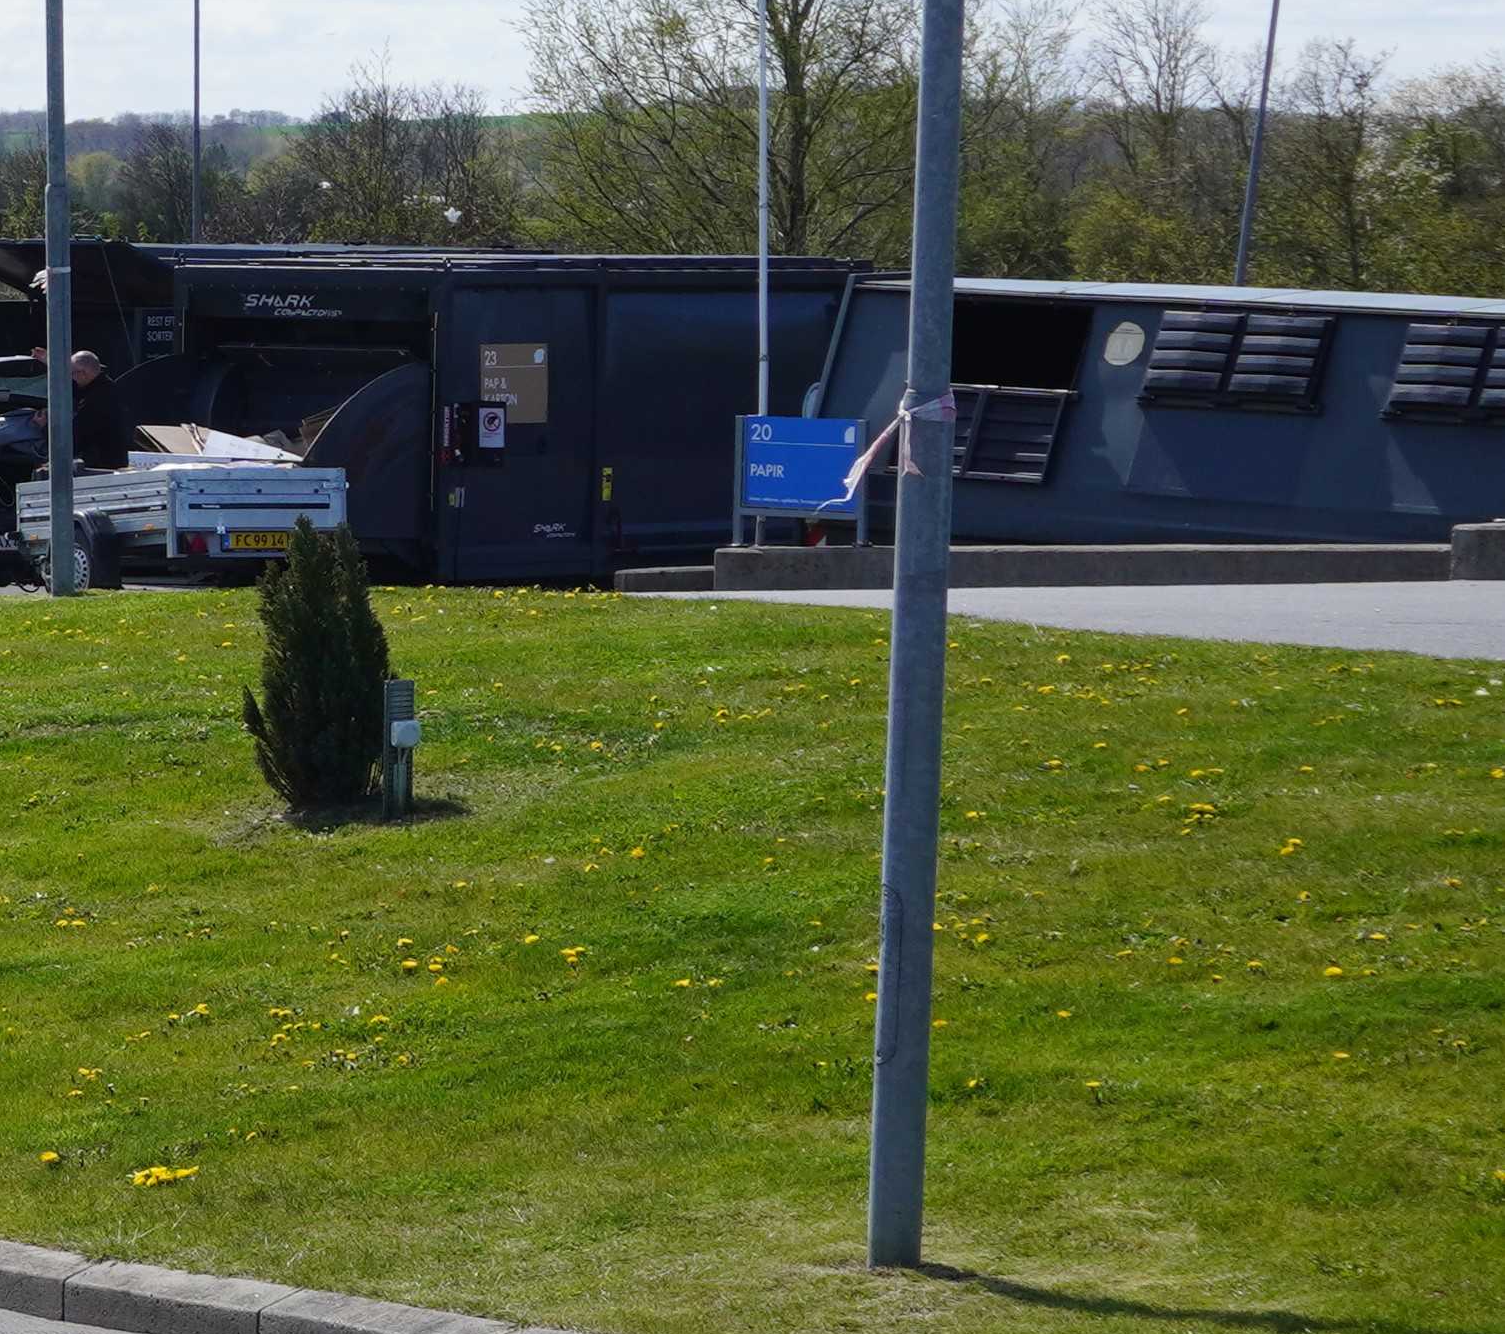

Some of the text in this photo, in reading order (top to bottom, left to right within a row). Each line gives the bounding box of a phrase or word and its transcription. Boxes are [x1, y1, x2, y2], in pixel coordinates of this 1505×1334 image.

[244, 293, 316, 308] SHARK
[484, 350, 497, 366] 23
[484, 377, 500, 389] PAP
[750, 424, 772, 441] 20
[750, 464, 784, 478] PAPIR
